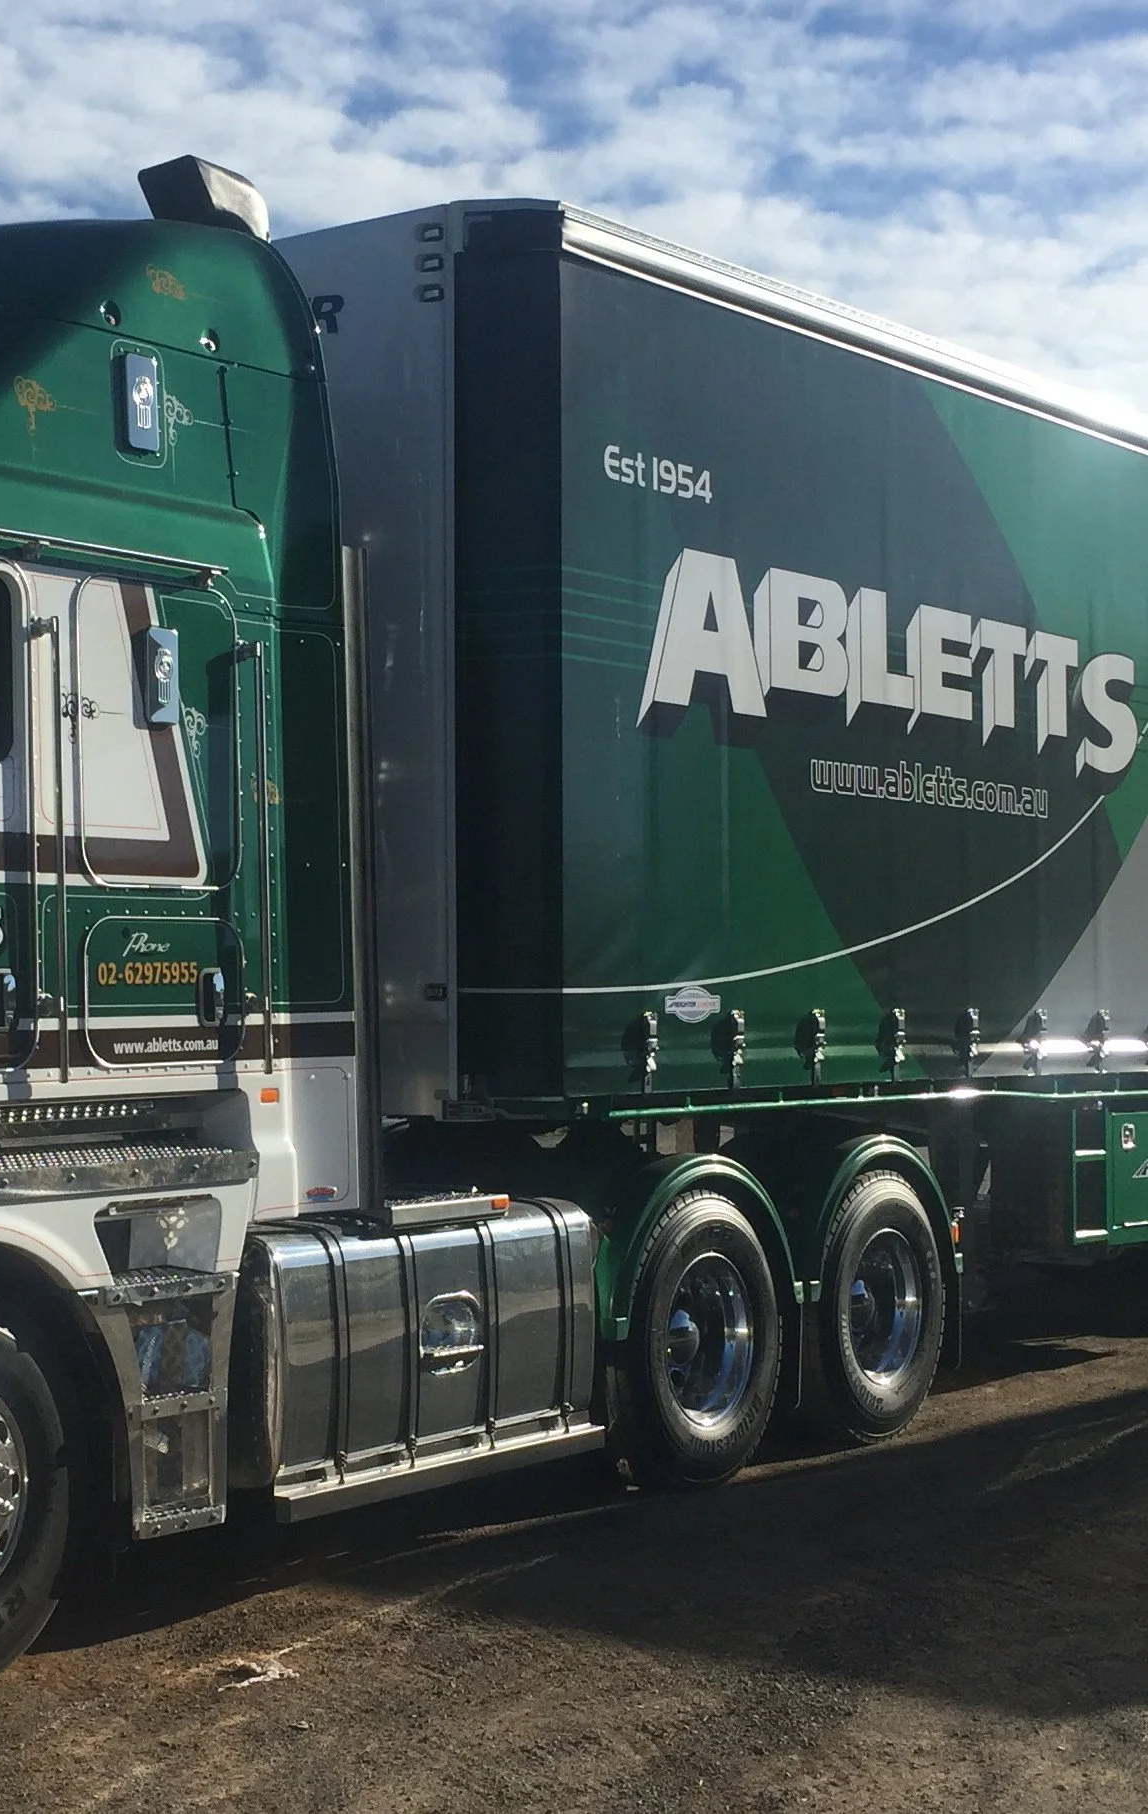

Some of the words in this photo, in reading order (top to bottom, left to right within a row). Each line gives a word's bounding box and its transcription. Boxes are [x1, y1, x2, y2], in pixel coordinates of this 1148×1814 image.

[603, 444, 646, 488] Est
[652, 456, 714, 504] 1954
[636, 547, 1138, 778] ABLETTS
[810, 758, 1049, 819] www.abletts.com.au
[122, 931, 171, 957] Phone
[97, 960, 198, 987] 02-62975955
[113, 1037, 219, 1055] www.abletts.com.au
